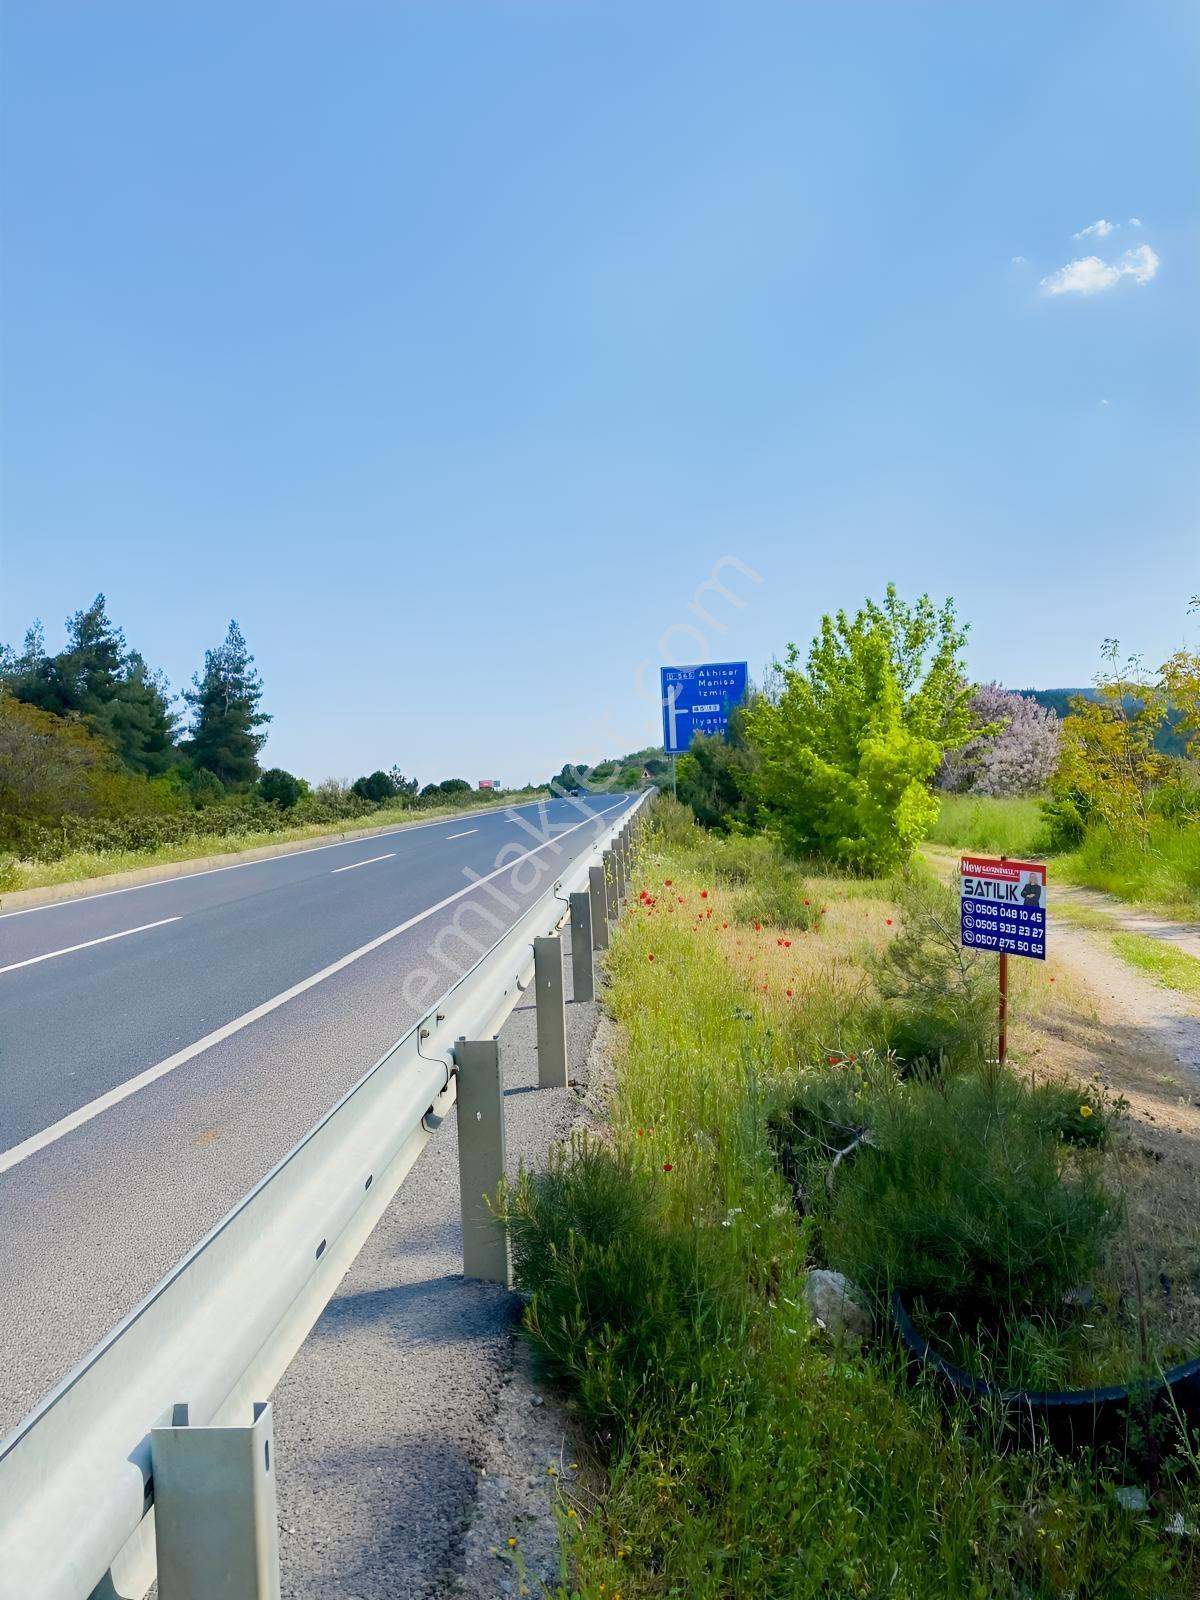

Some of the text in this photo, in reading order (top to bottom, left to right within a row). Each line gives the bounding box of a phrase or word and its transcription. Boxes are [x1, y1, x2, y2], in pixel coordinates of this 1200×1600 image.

[963, 860, 982, 874] New
[964, 878, 1018, 902] SATILIK
[976, 904, 1042, 922] 0506 048 10 45
[976, 919, 1044, 938] 0505 933 23 27
[976, 934, 1042, 954] 0507 275 50 62
